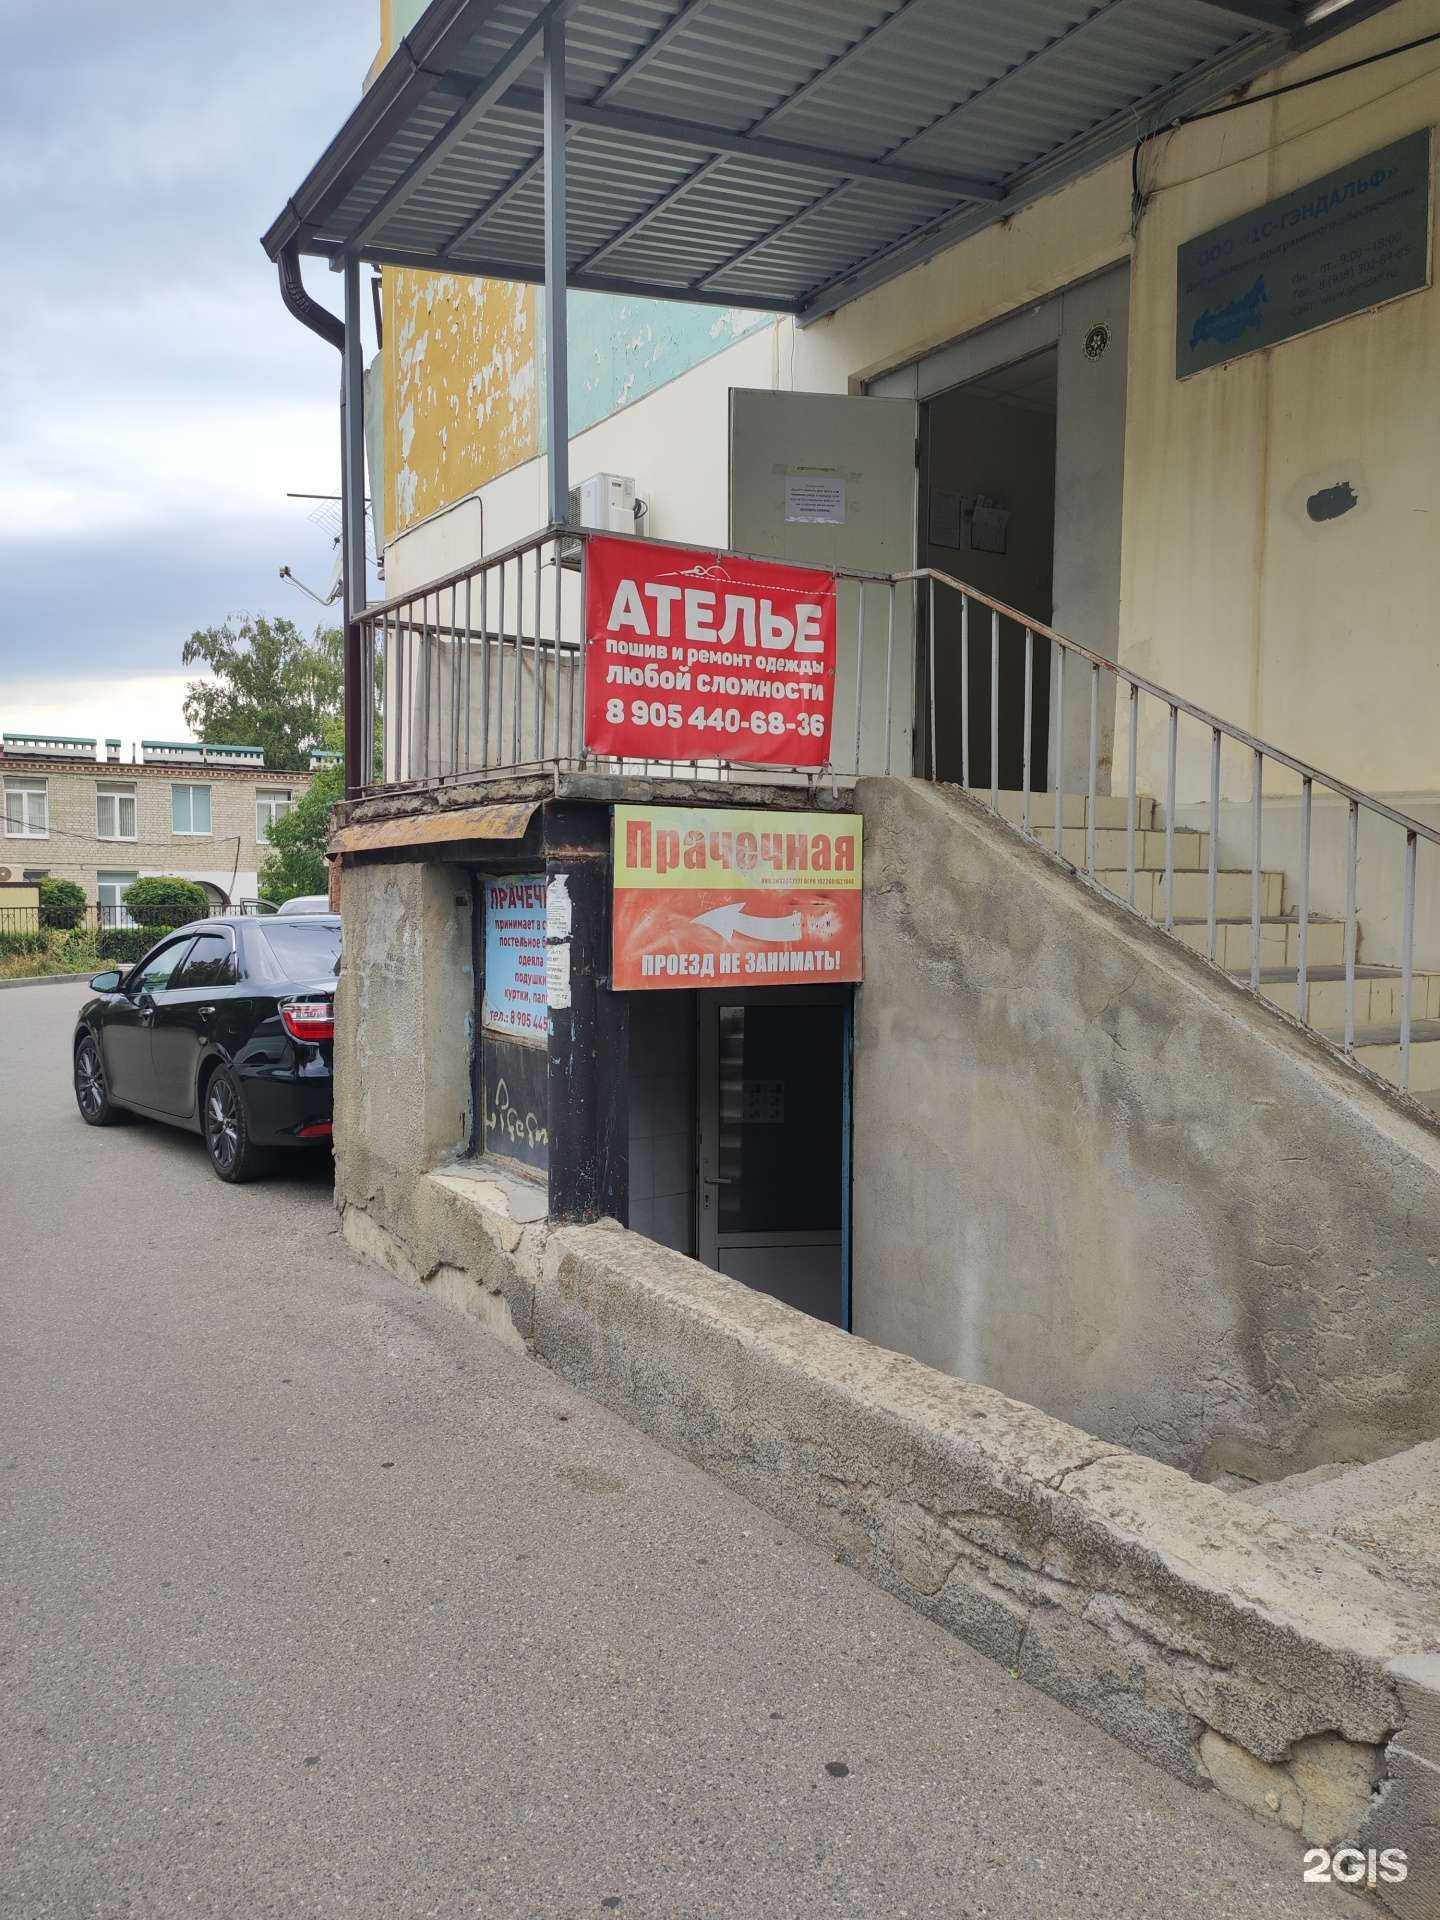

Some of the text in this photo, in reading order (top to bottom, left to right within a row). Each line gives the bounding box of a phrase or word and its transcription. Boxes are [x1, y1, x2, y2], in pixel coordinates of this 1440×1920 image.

[606, 579, 825, 653] АТЕЛЬЕ
[605, 639, 824, 676] пошив и ремонт одежды
[606, 664, 824, 701] любой сложности
[606, 699, 825, 737] 8 905 440-68-36
[626, 821, 854, 874] Прачечная
[495, 919, 536, 932] принимает
[499, 935, 541, 949] постельное
[518, 955, 544, 967] одеяла
[641, 950, 841, 977] ПРОЕЗД НЕ ЗАНИМАТЬ!
[510, 1010, 516, 1025] 8
[517, 1011, 531, 1028] 905
